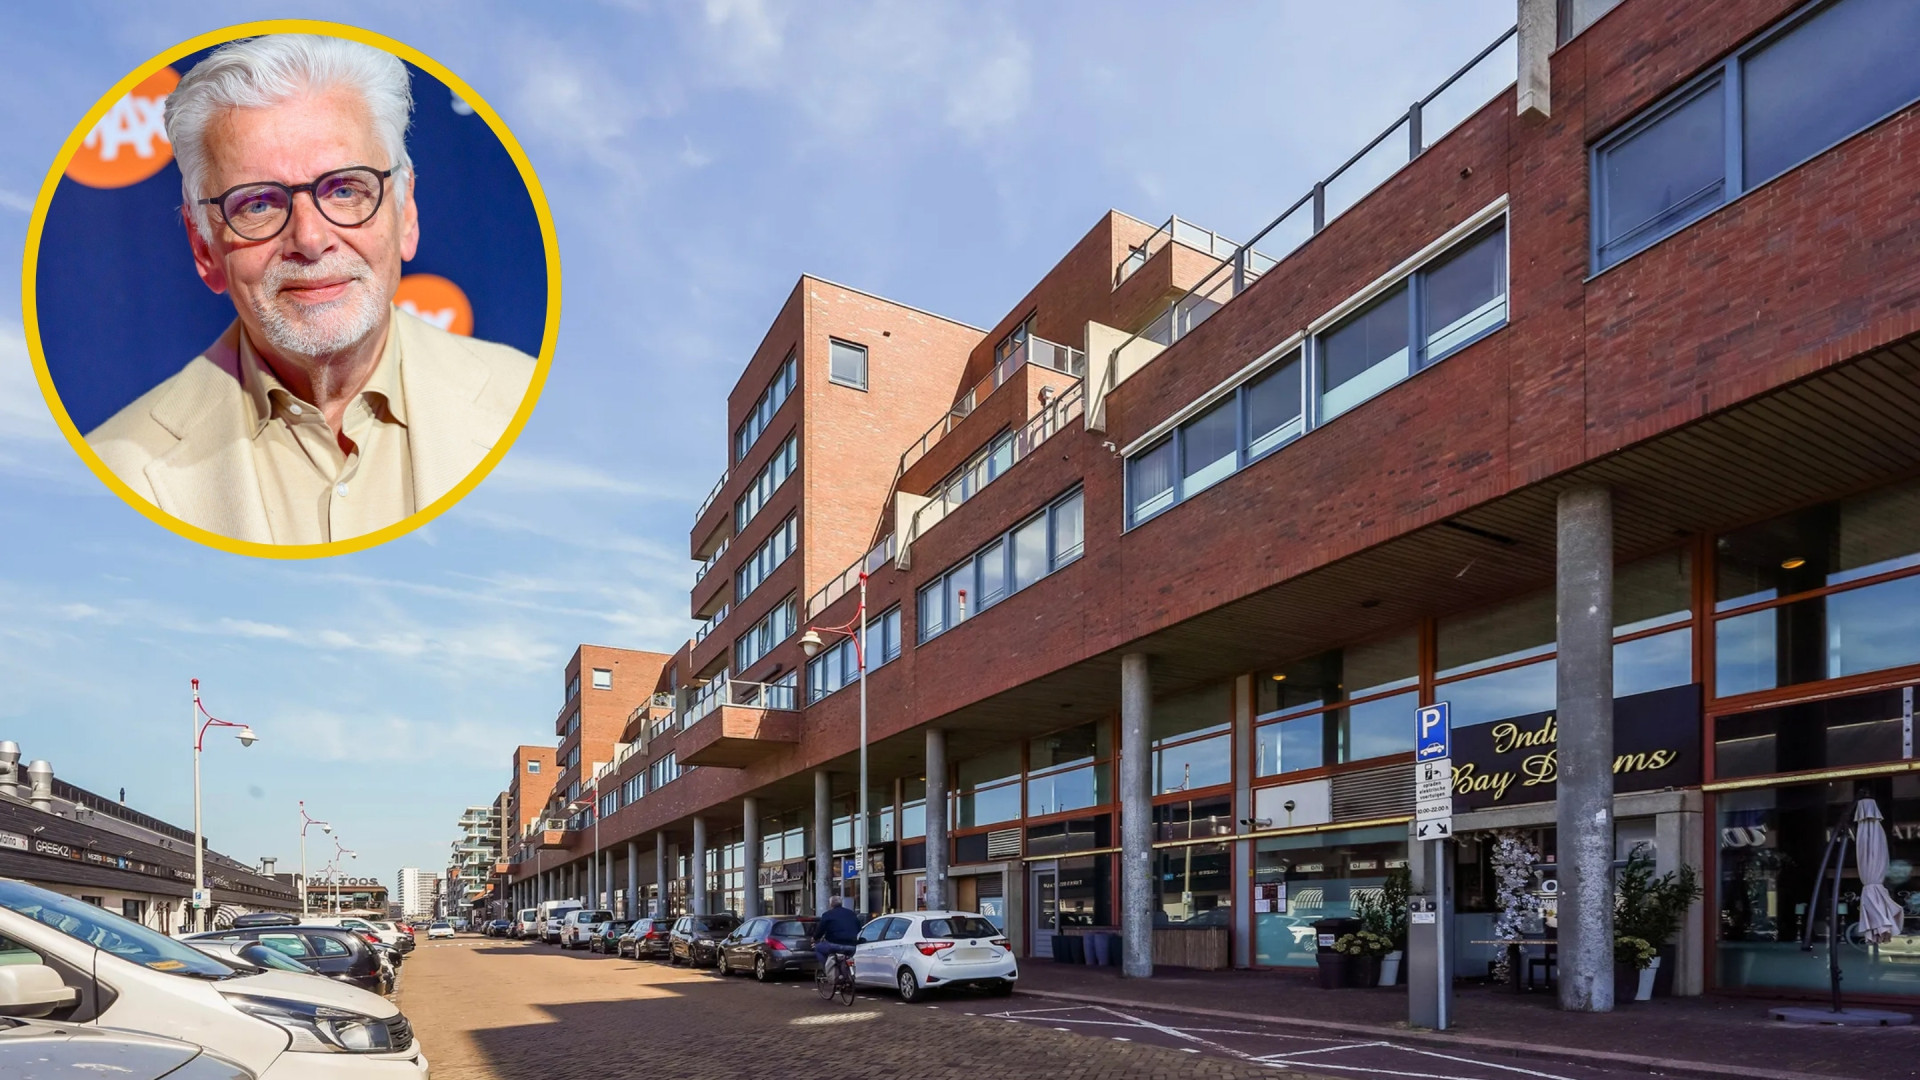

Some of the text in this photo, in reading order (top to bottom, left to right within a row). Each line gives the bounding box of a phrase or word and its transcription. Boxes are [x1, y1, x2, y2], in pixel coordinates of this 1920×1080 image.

[1422, 709, 1440, 739] P
[1492, 716, 1557, 753] Indi
[1451, 749, 1677, 800] Bay Dms
[1419, 786, 1446, 795] elektrische
[1423, 781, 1441, 789] opladen
[1420, 791, 1445, 800] voertuigen
[35, 840, 69, 857] GREEKZ
